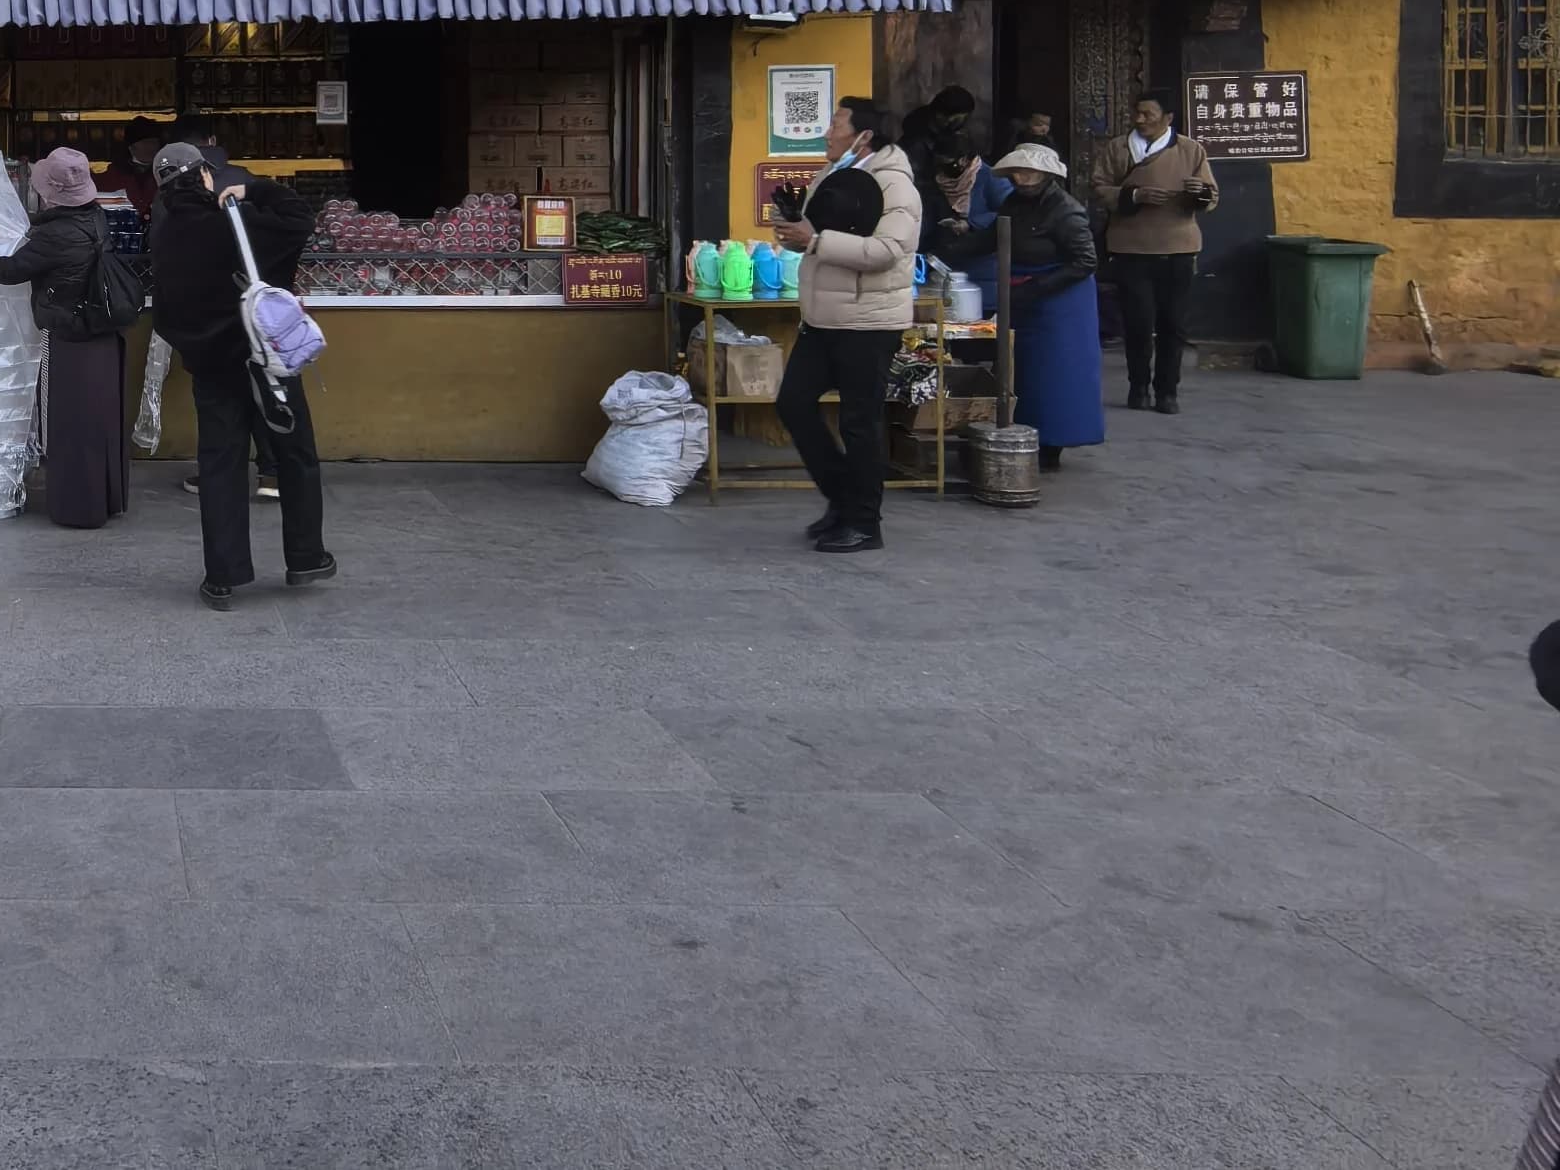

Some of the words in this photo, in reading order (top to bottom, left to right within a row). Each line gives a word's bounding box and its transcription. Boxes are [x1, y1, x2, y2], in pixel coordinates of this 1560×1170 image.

[1194, 81, 1298, 100] 请保管好
[1196, 102, 1298, 119] 自身贵重物品
